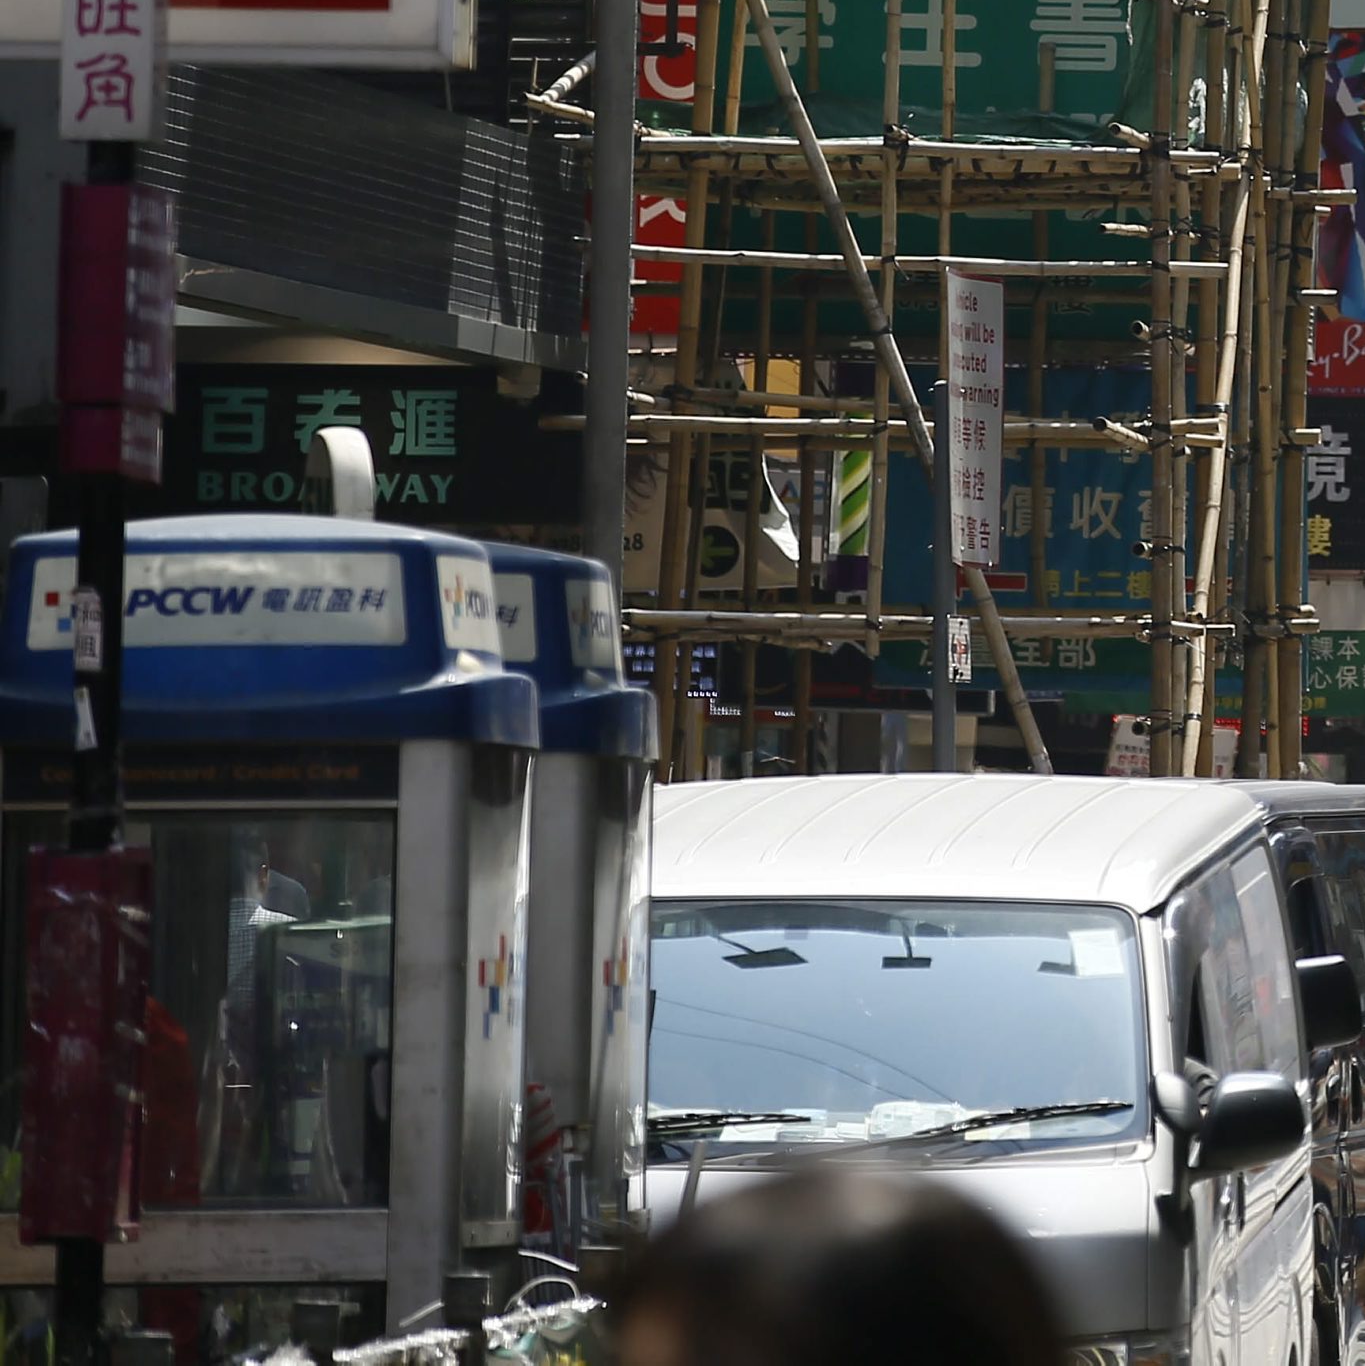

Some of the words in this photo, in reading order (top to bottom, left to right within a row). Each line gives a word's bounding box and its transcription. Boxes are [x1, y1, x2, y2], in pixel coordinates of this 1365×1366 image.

[197, 471, 454, 505] BROWAY
[127, 586, 255, 618] PCCW
[262, 587, 388, 614] 電訊盈科
